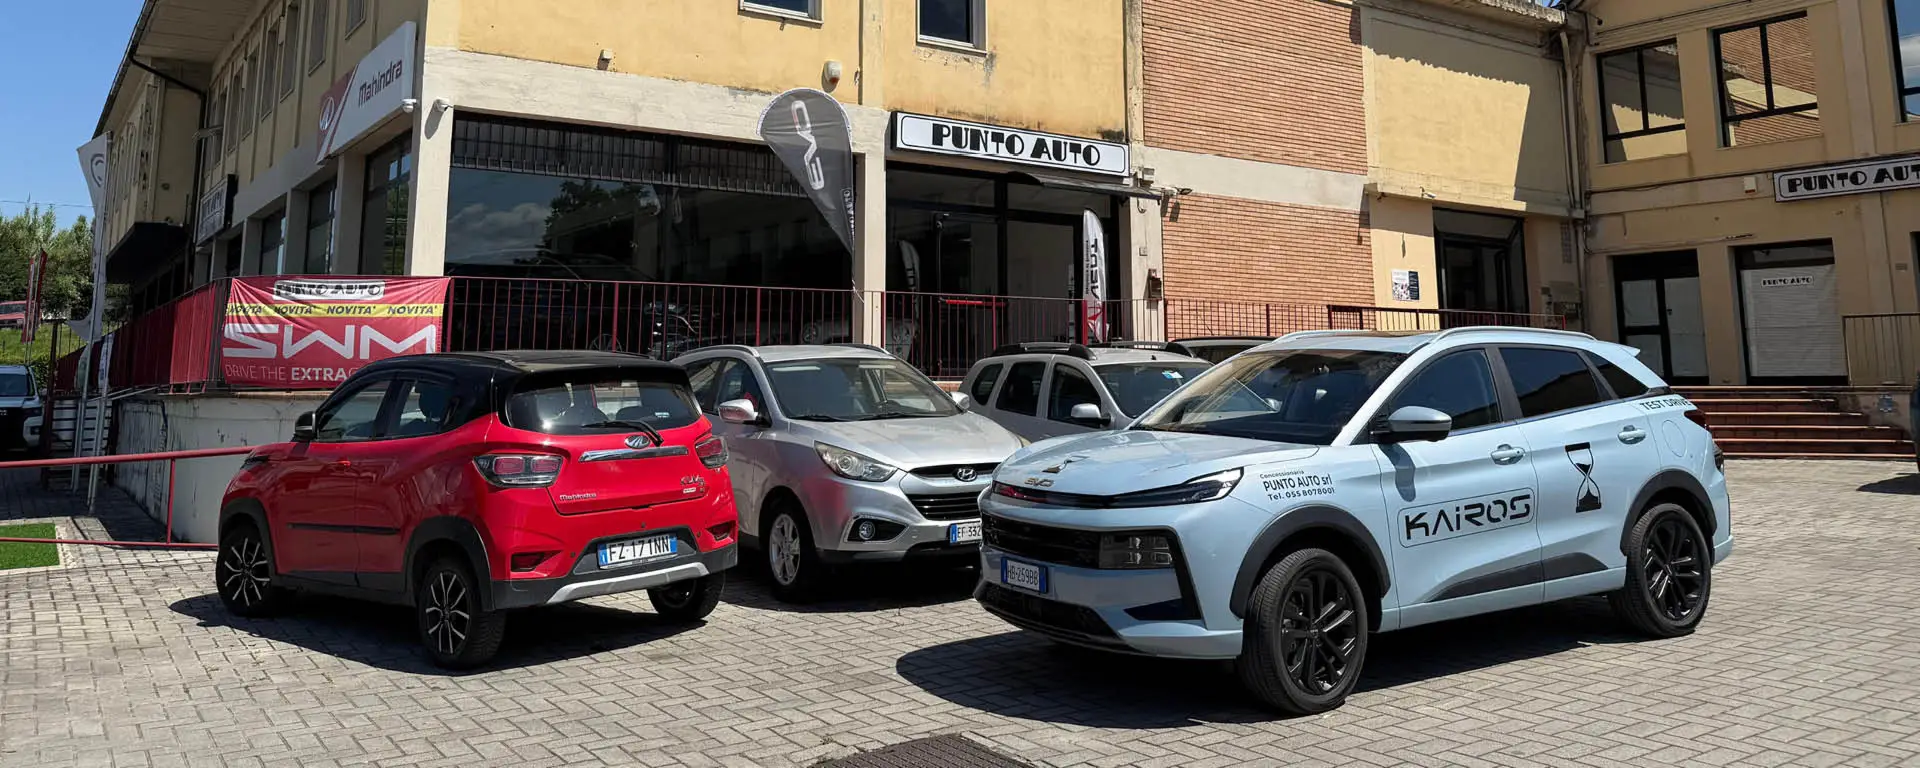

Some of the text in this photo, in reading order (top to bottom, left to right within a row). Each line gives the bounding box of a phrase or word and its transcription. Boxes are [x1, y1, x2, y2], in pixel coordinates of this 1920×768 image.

[358, 60, 403, 108] Mahindra
[791, 100, 825, 190] EVO
[931, 122, 1101, 167] PUNTO AUTO
[1787, 170, 1868, 193] PUNTO
[330, 284, 381, 295] AUTO
[327, 304, 376, 315] NOVITA'
[387, 304, 438, 315] NOVITA'
[222, 323, 436, 360] SWM
[225, 364, 257, 379] DRIVE
[260, 365, 286, 380] THE
[1639, 400, 1665, 411] TEST
[1263, 473, 1332, 491] PUNTO AUTO srl
[1285, 490, 1301, 499] 055
[1302, 487, 1335, 497] 8078001
